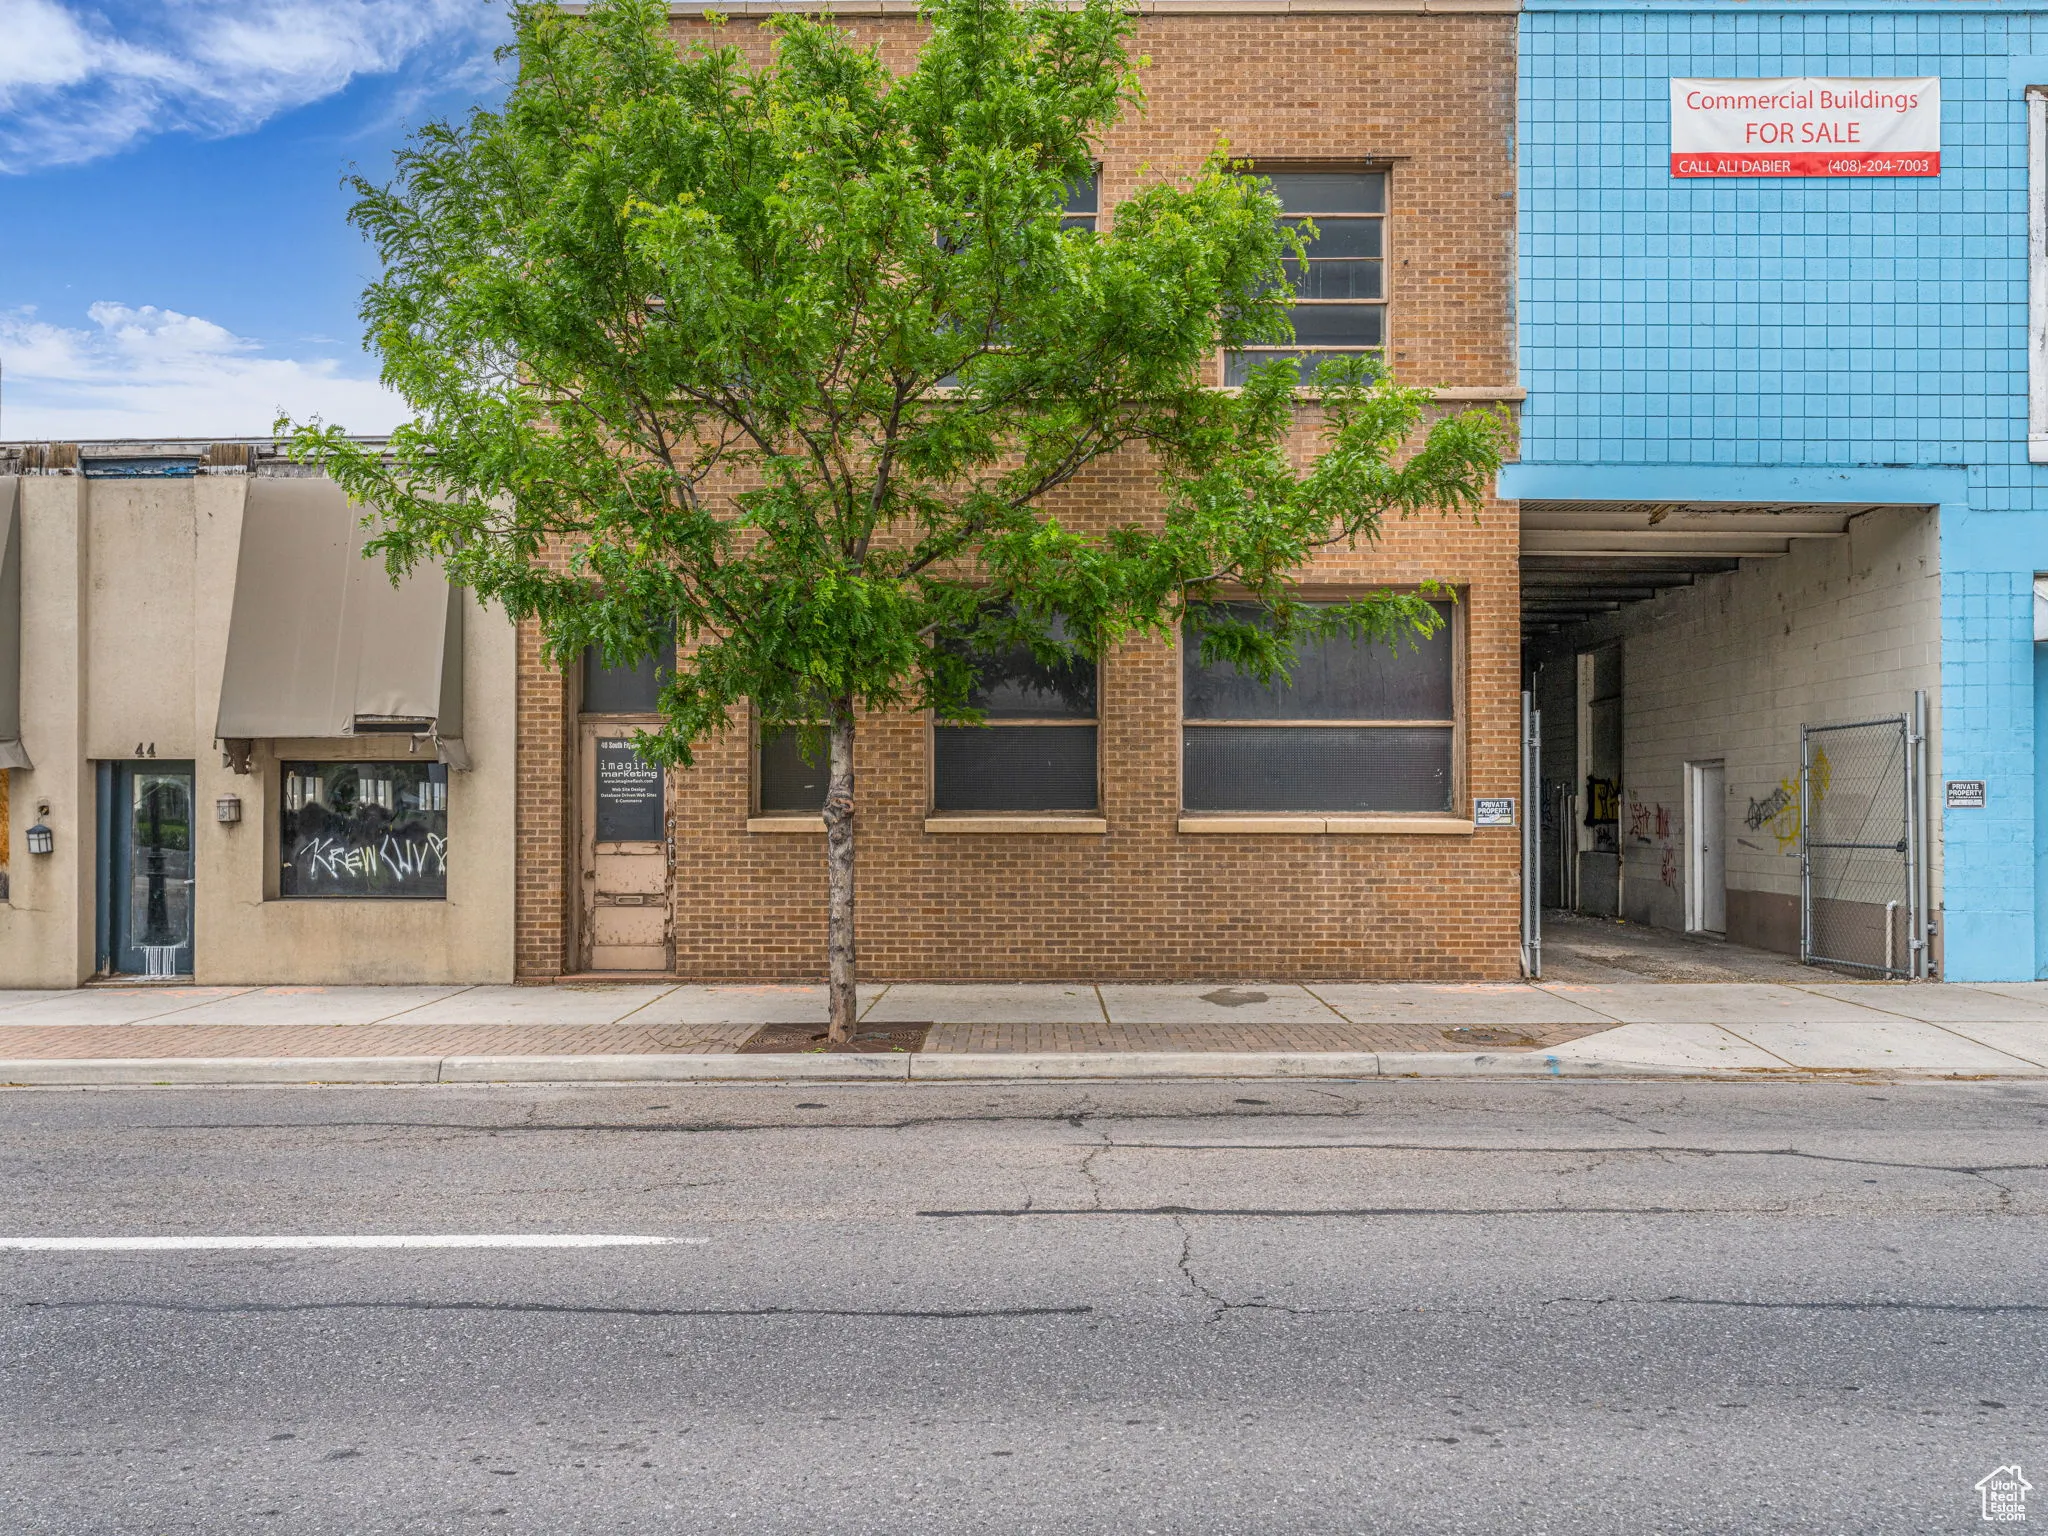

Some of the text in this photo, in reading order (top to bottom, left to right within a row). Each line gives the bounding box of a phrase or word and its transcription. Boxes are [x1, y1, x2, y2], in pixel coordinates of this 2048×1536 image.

[1686, 90, 1918, 112] Commercial Buildings
[1746, 121, 1861, 144] FOR SALE
[1679, 160, 1791, 173] CALL ALI DABIER
[1827, 159, 1929, 173] (408)-204-7003
[135, 742, 156, 758] 44
[601, 770, 658, 779] marketing
